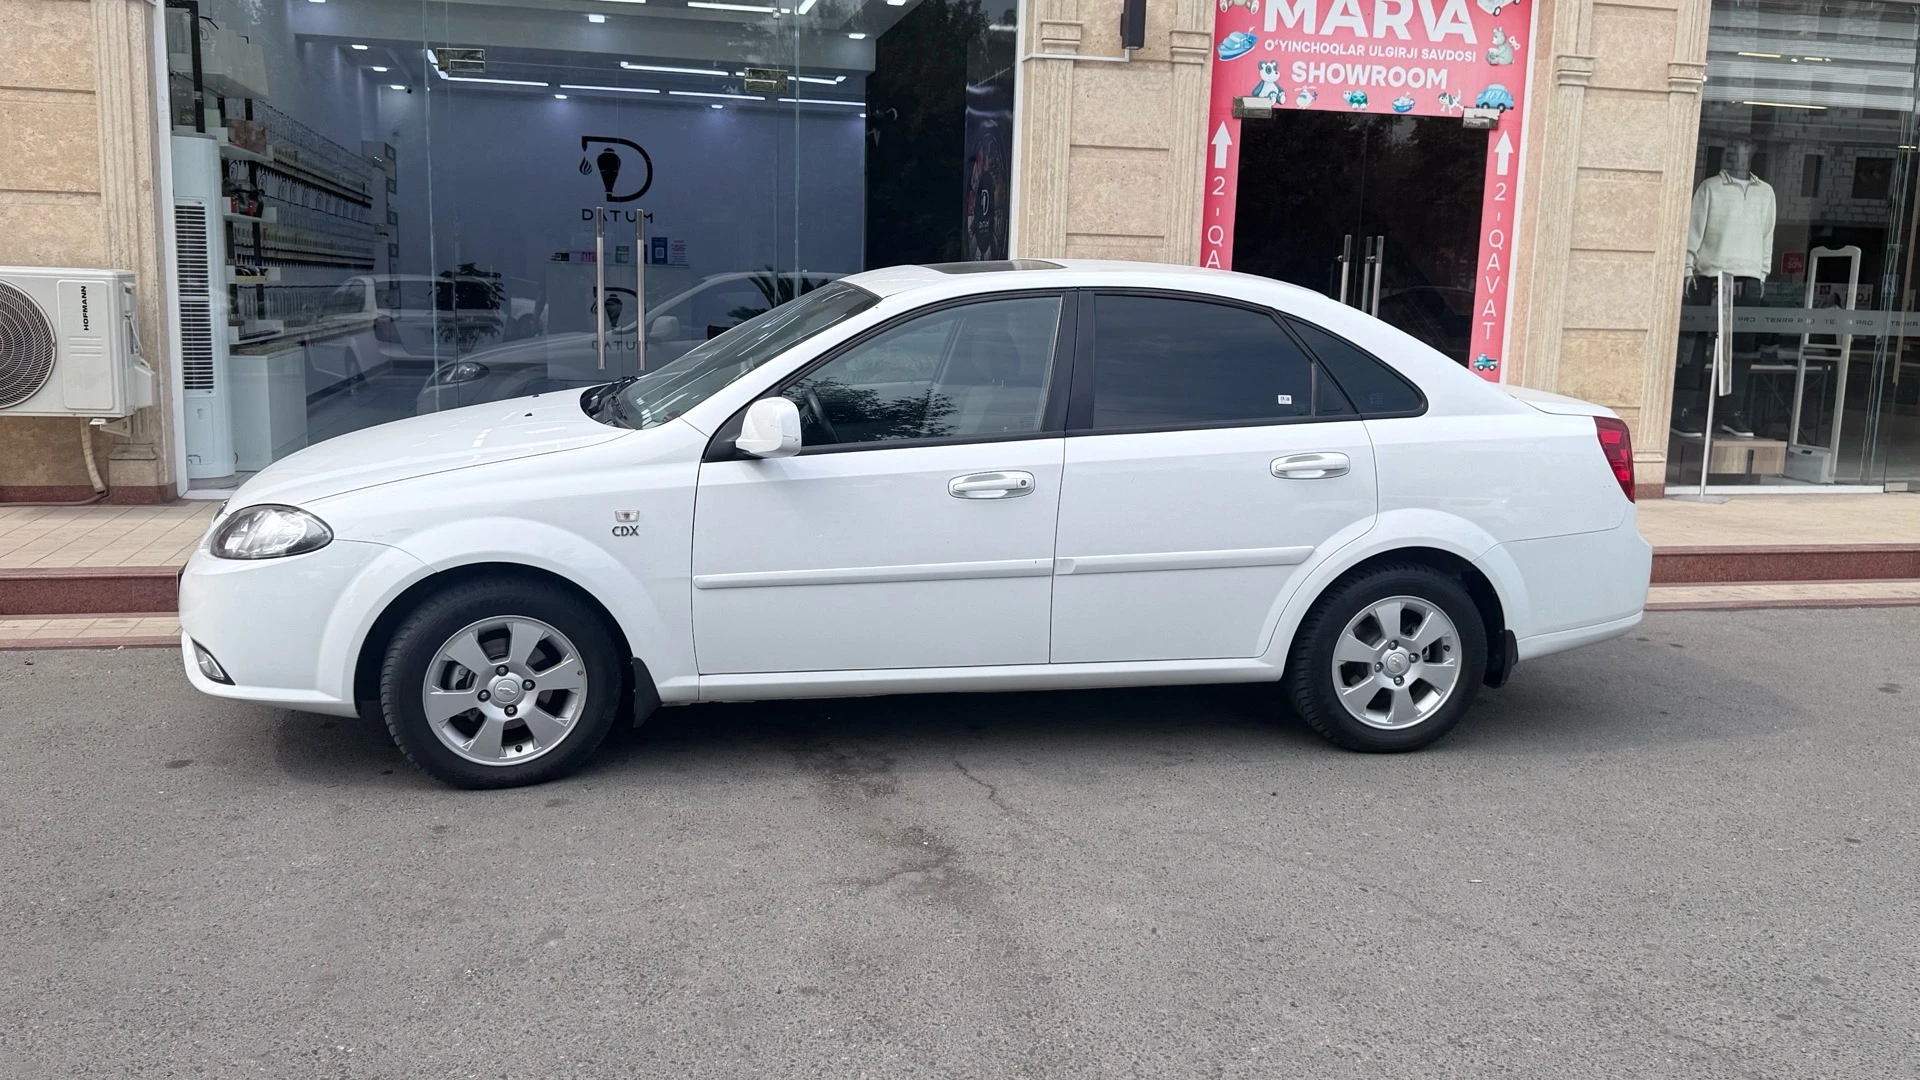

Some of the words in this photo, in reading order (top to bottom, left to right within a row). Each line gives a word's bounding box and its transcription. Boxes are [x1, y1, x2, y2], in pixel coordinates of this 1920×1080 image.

[1263, 0, 1478, 44] MARVA
[1369, 45, 1418, 59] ULGIRJI
[1421, 48, 1477, 63] SAVDOSI
[1291, 61, 1448, 89] SHOWROOM
[1205, 176, 1226, 268] 2-QA
[81, 285, 89, 331] HOFMANN
[612, 525, 639, 537] CDX
